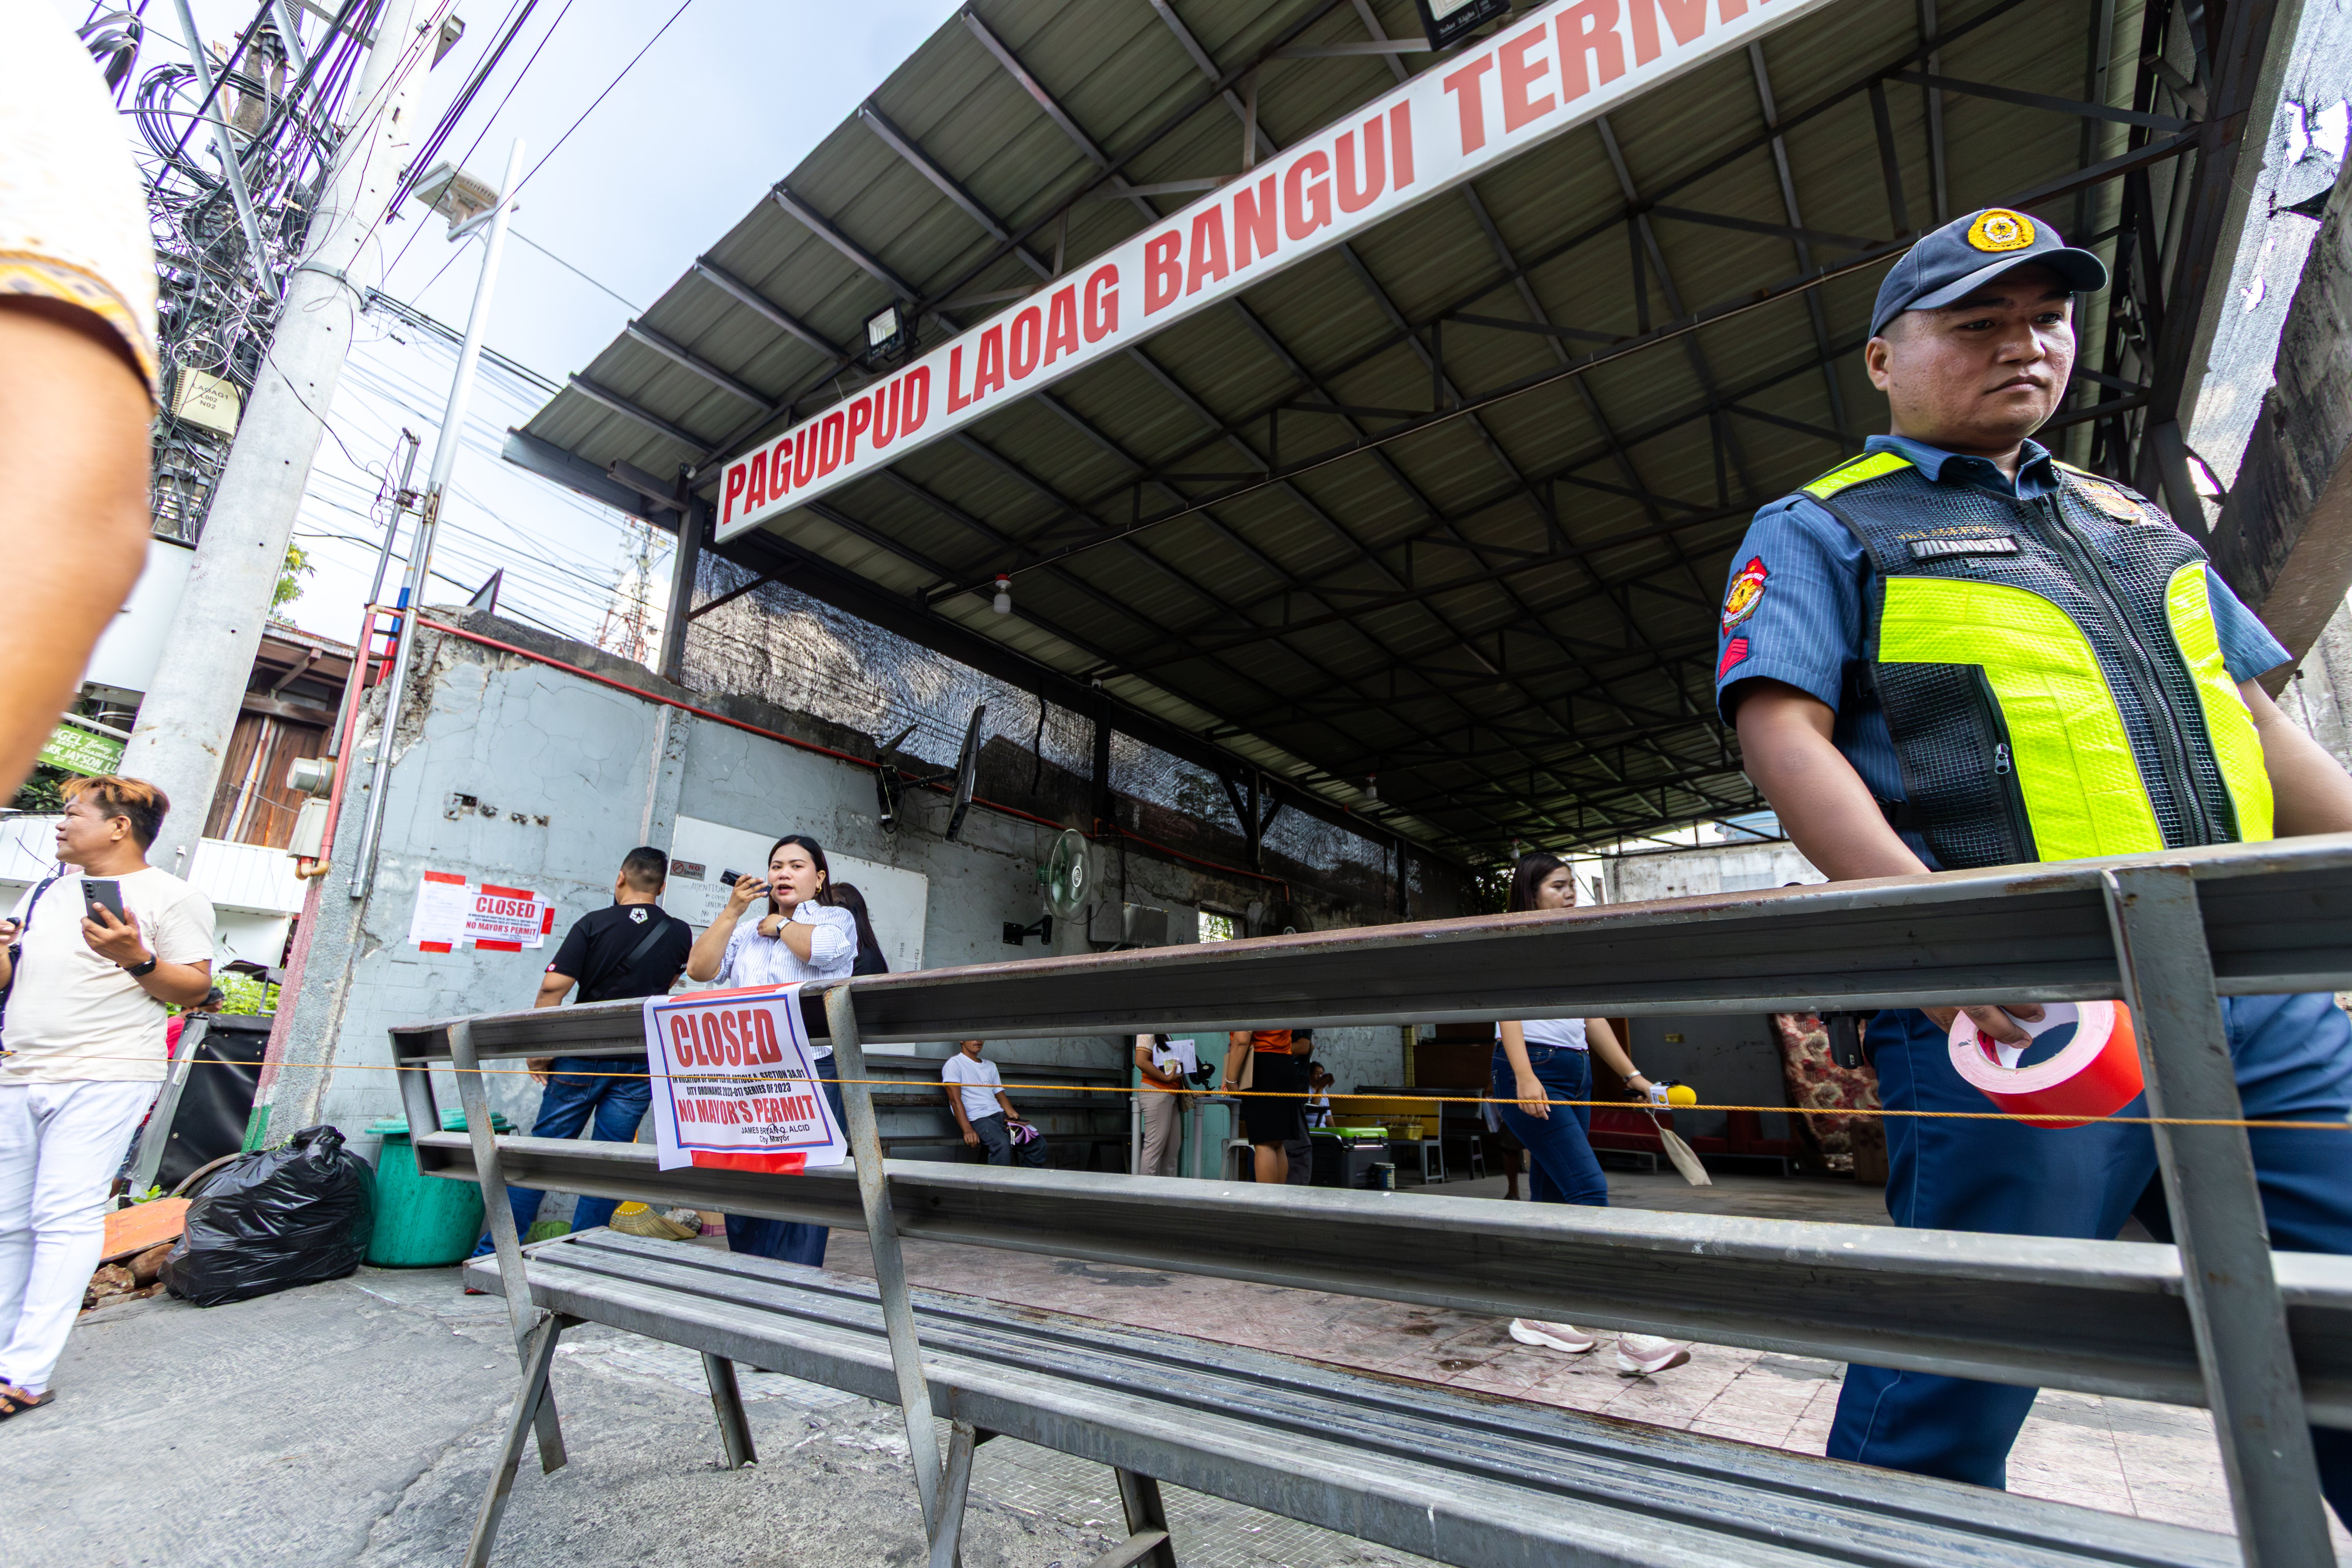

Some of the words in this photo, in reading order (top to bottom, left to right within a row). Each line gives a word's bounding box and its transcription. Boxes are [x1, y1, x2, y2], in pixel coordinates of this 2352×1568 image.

[723, 366, 930, 524] PAGUDPUD
[947, 264, 1118, 414] LAOAG
[1145, 100, 1414, 316] BANGUI
[1910, 537, 2019, 558] VILLANUEVA
[62, 749, 104, 769] JAYSON
[476, 897, 535, 918] CLOSED
[478, 923, 509, 933] MAYOR'S
[511, 926, 537, 936] PERMIT
[670, 1009, 783, 1068] CLOSED
[731, 1073, 752, 1084] ARTICLE
[760, 1069, 786, 1081] SECTION
[787, 1069, 806, 1079] 3A.01
[686, 1086, 697, 1096] CITY
[698, 1086, 722, 1096] ORDINANCE
[722, 1087, 744, 1097] 2023-017
[744, 1084, 766, 1095] SERIES
[766, 1084, 773, 1093] OF
[774, 1082, 791, 1093] 2023
[677, 1099, 696, 1123] NO
[696, 1099, 753, 1125] MAYOR'S
[751, 1095, 816, 1124] PERMIT
[760, 1125, 779, 1135] BRYAN
[789, 1124, 810, 1132] ALCID
[759, 1135, 768, 1145] City
[769, 1135, 790, 1144] Mayor
